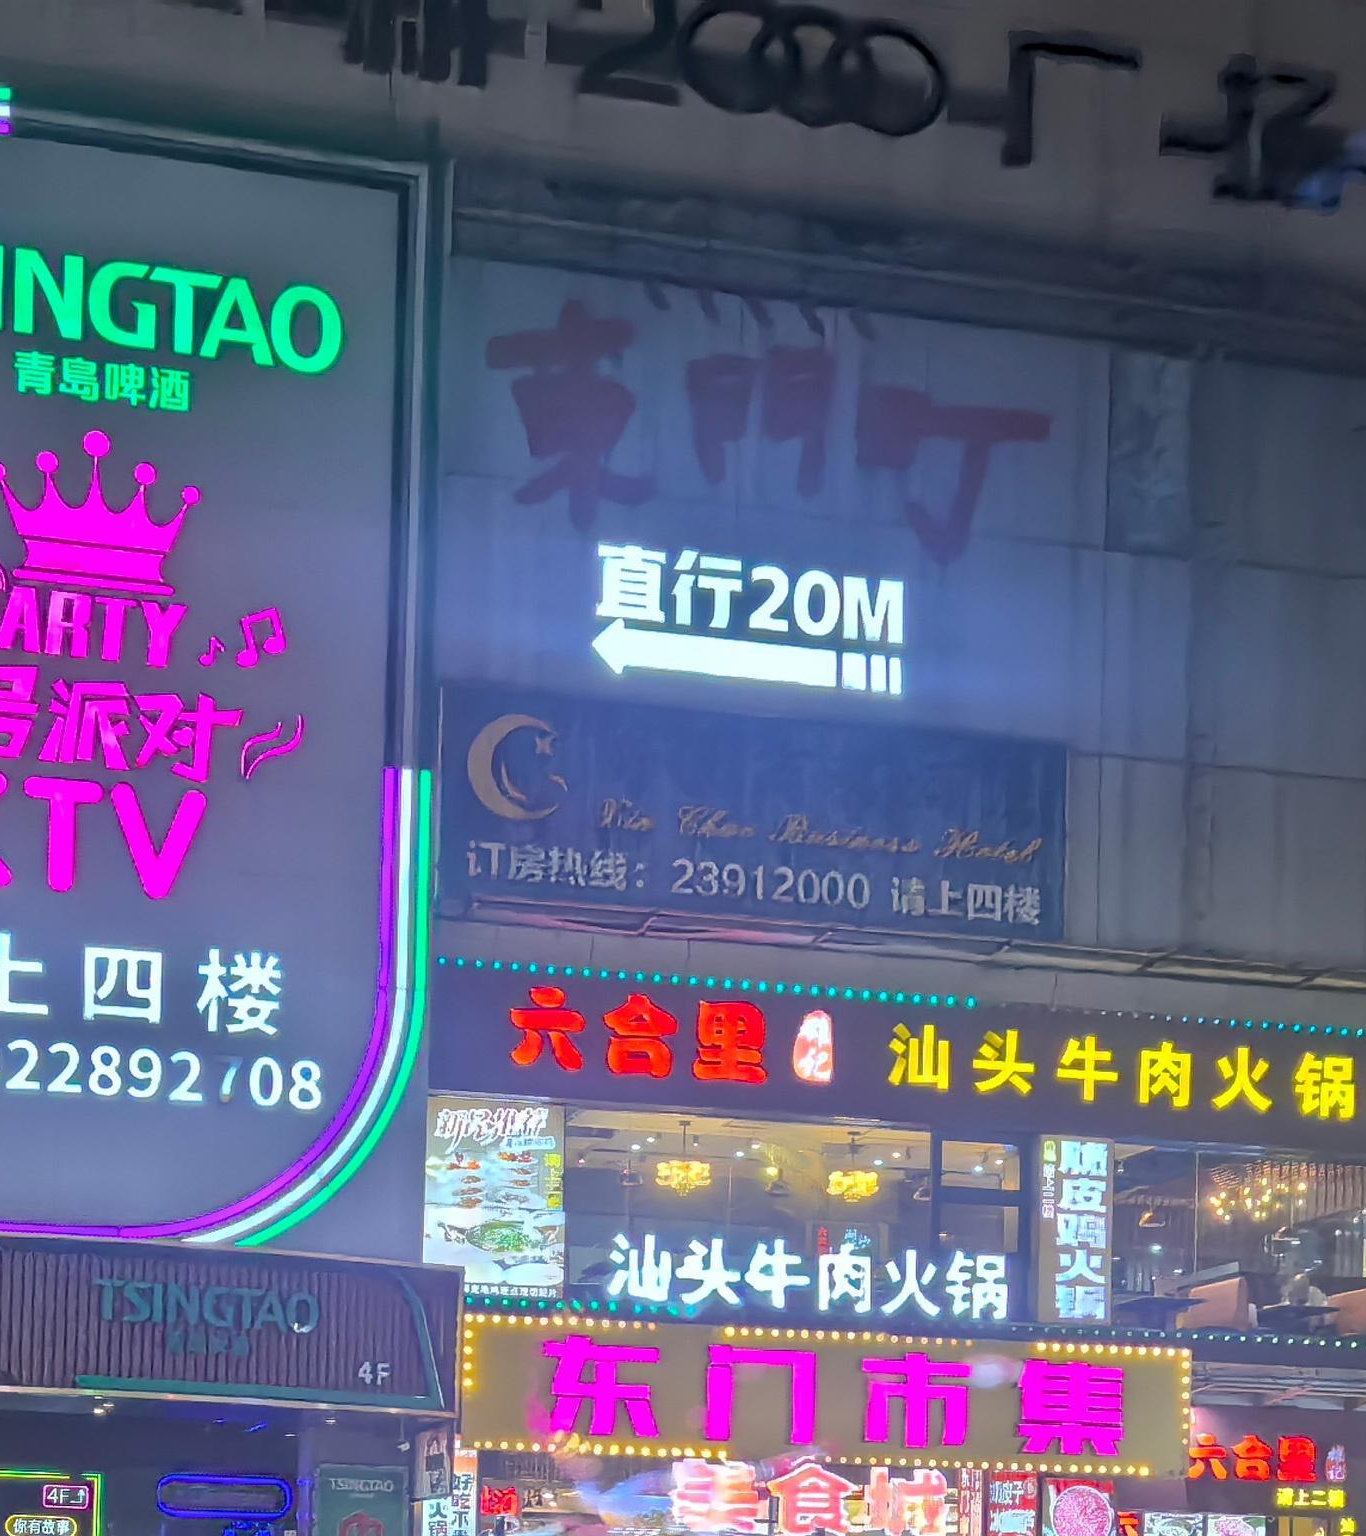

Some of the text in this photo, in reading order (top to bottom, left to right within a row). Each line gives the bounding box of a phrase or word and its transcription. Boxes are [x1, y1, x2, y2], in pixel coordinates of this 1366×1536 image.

[13, 350, 192, 412] 青岛啤酒
[595, 542, 906, 646] 直行20M
[670, 857, 871, 911] 23912000
[890, 875, 1042, 926] 请上四楼
[509, 985, 768, 1085] 六合里
[609, 1231, 1009, 1322] 汕头牛肉火锅
[93, 1278, 321, 1335] TSINGTAO
[358, 1361, 391, 1385] 4F
[542, 1334, 1125, 1457] 东门市集
[329, 1478, 394, 1493] TSINGTAO
[1188, 1434, 1317, 1483] 六合里
[46, 1488, 70, 1504] 4F
[12, 1518, 71, 1535] 你有故事
